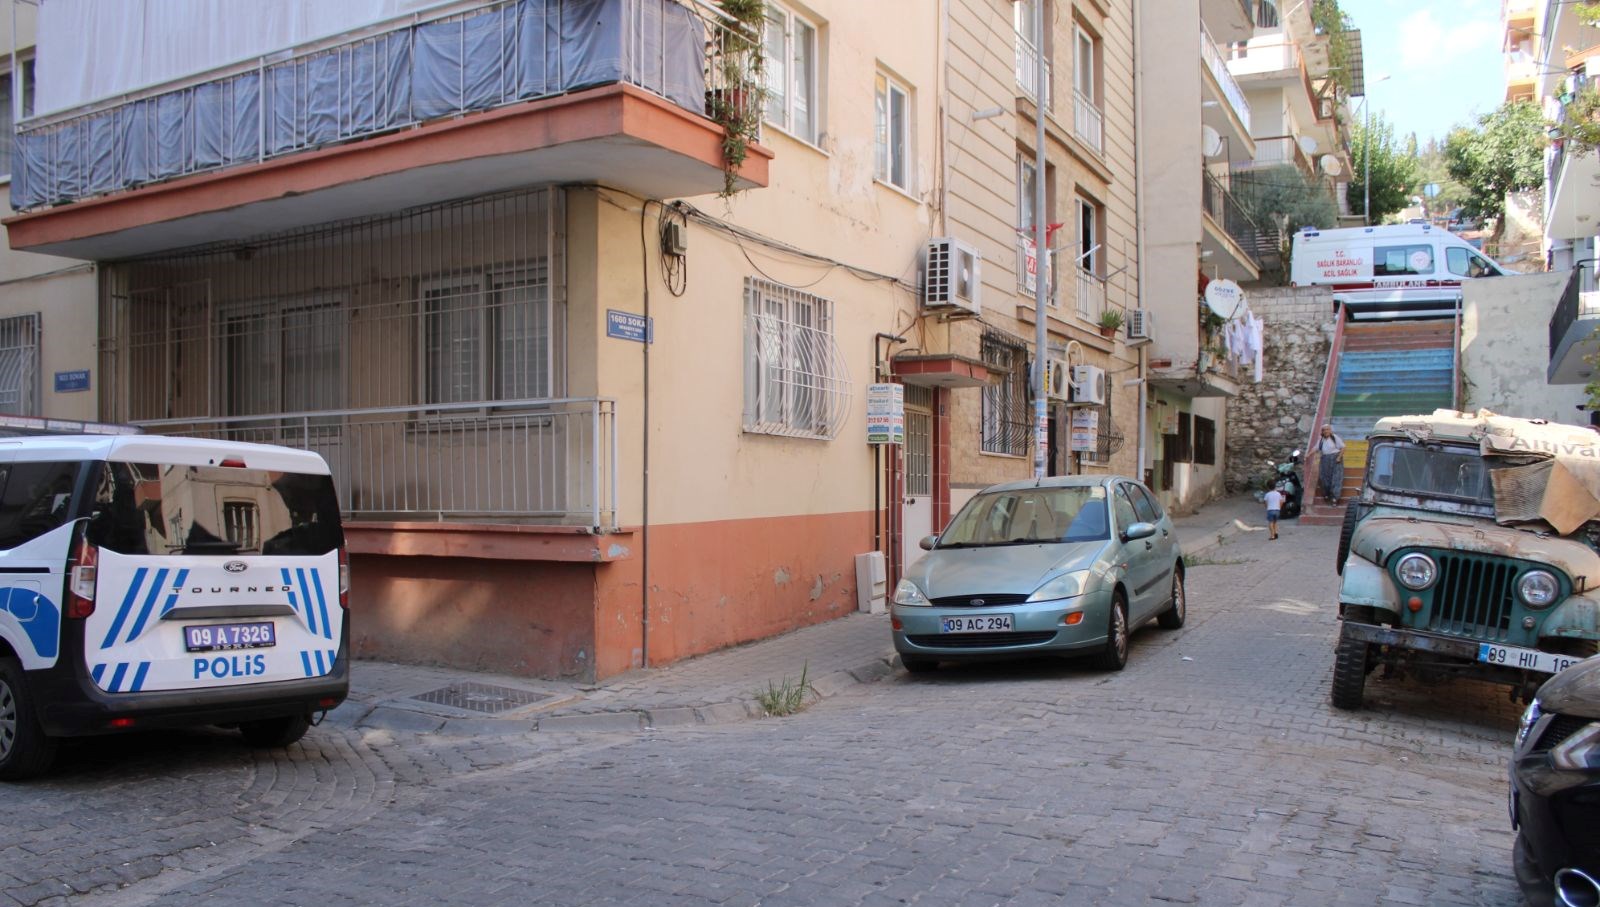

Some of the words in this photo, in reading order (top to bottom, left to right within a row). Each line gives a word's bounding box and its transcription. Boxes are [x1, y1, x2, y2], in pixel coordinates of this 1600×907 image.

[628, 317, 646, 328] SOKA
[1509, 436, 1600, 458] Altiva
[949, 619, 962, 631] 09
[967, 619, 984, 630] AC
[988, 618, 1010, 630] 294
[191, 629, 212, 645] 09
[217, 627, 228, 644] A
[231, 625, 270, 643] 7326
